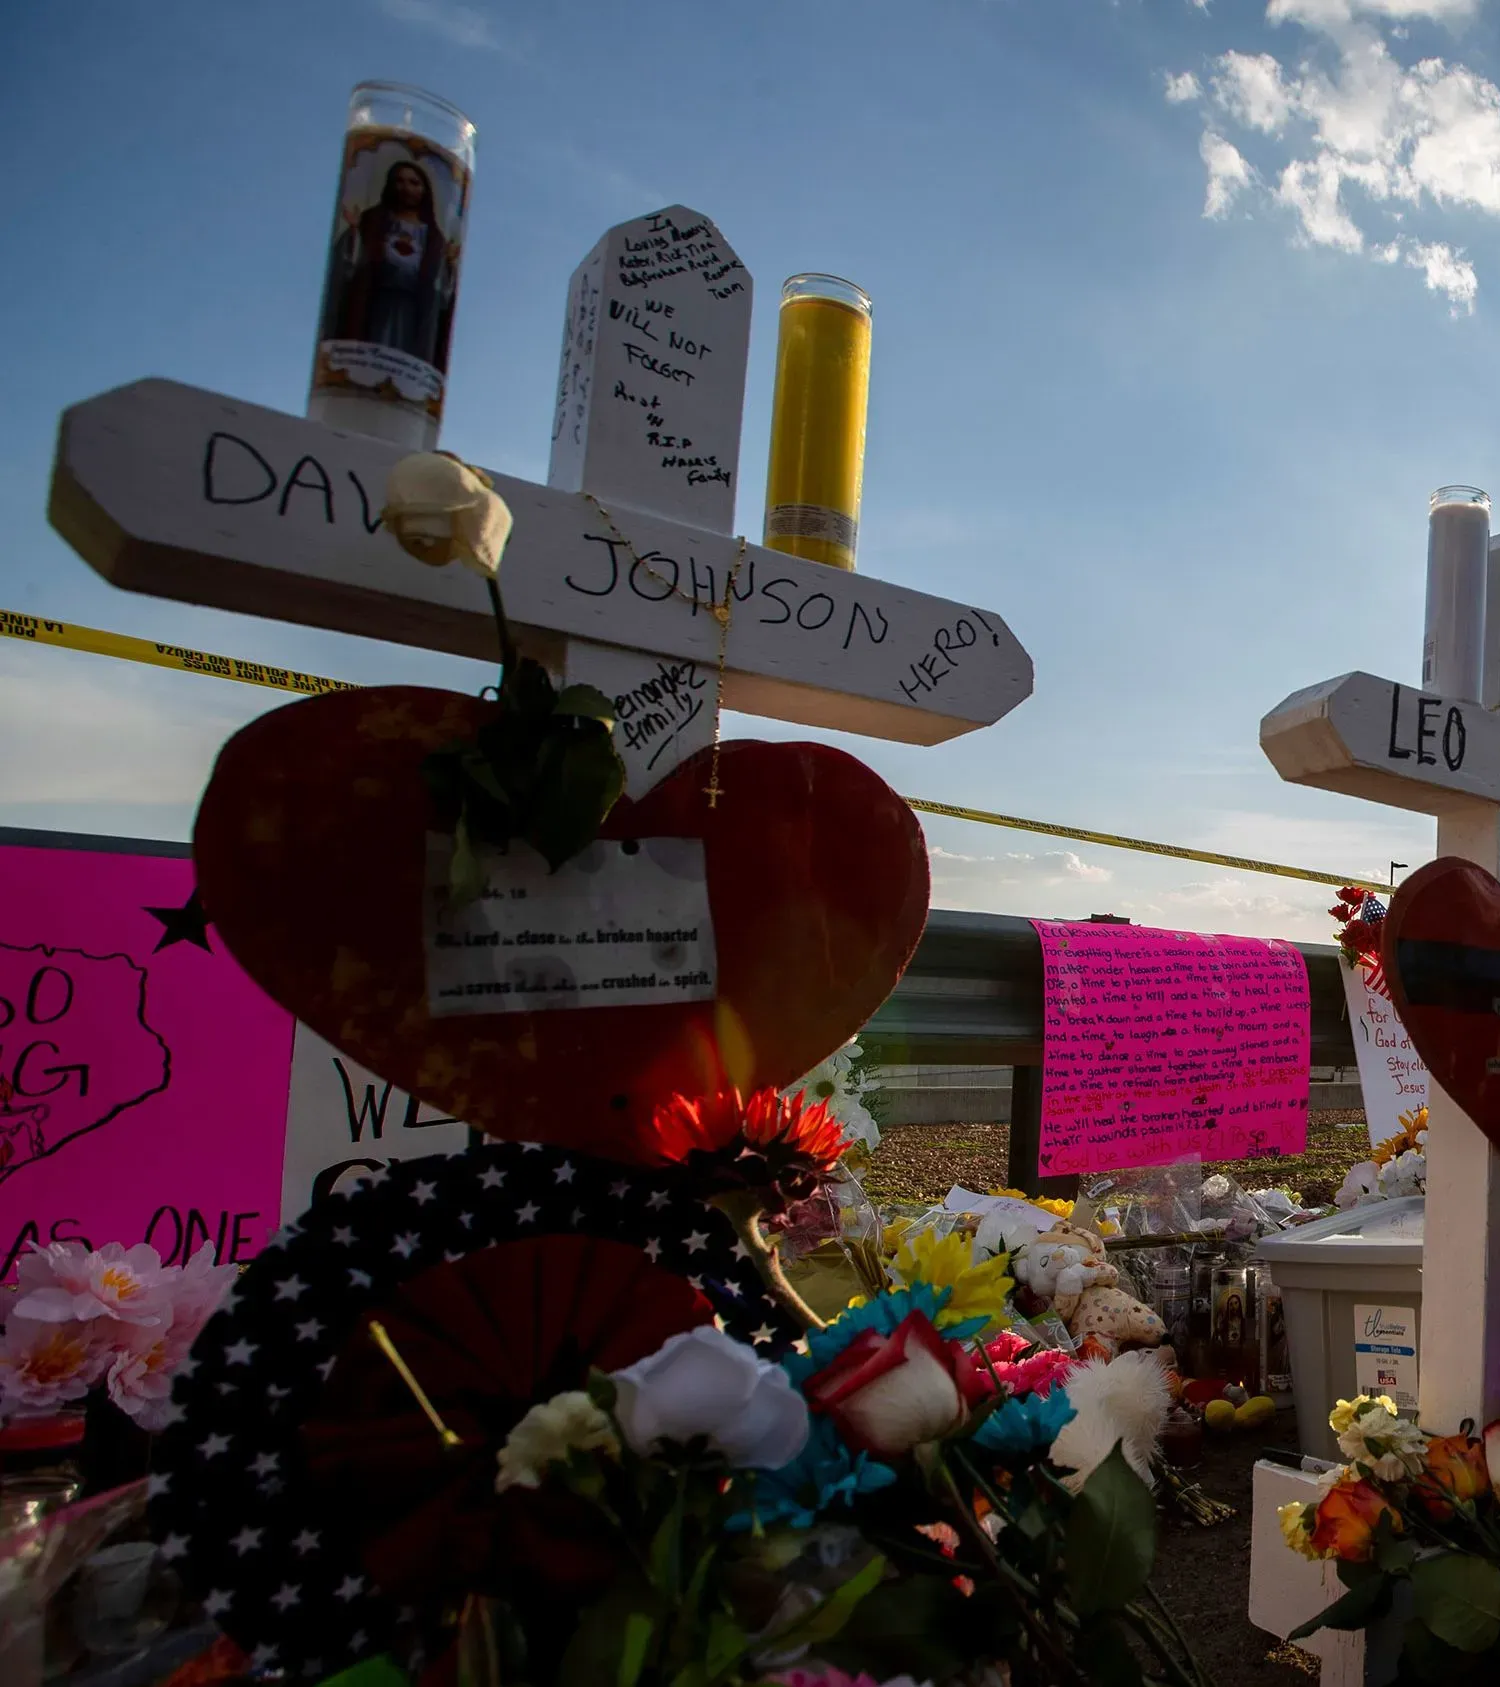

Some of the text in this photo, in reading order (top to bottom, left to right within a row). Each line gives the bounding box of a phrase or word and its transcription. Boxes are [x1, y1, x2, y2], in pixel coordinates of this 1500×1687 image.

[645, 300, 675, 318] WE
[669, 331, 712, 360] NOT
[44, 620, 64, 634] LA
[565, 533, 1003, 703] JOHNSON HERO!
[183, 658, 232, 675] CROSS
[235, 660, 289, 678] POLICIA
[236, 669, 265, 682] NOT
[613, 662, 707, 722] ernandez
[1388, 682, 1466, 772] LEO
[464, 930, 499, 947] Lord
[516, 929, 555, 945] close
[596, 928, 645, 944] broken
[646, 926, 698, 943] hearted
[1091, 965, 1124, 976] under
[466, 981, 511, 997] saves
[601, 972, 656, 990] crushed
[674, 970, 712, 988] spirit.
[1081, 976, 1106, 988] time
[1125, 975, 1151, 989] plant
[1155, 975, 1171, 985] and
[1102, 991, 1127, 1003] time
[1171, 992, 1188, 1000] and
[1134, 1013, 1153, 1023] and
[1165, 1009, 1187, 1020] time
[1206, 1006, 1233, 1019] build
[1366, 998, 1389, 1024] for
[1046, 1032, 1067, 1042] and
[1082, 1028, 1107, 1041] time
[1129, 1029, 1159, 1044] laugh
[1272, 1020, 1290, 1029] and
[1375, 1027, 1397, 1048] God
[1048, 1050, 1076, 1061] time
[1272, 1036, 1289, 1046] and
[1386, 1056, 1411, 1076] Stay
[1045, 1082, 1066, 1094] and
[1392, 1073, 1426, 1096] Jesus
[1044, 1121, 1062, 1134] He
[1065, 1117, 1089, 1131] will
[1120, 1112, 1138, 1123] the
[1229, 1101, 1250, 1115] and
[1044, 1133, 1081, 1148] their
[1087, 1125, 1137, 1144] wounds
[1054, 1147, 1089, 1174] God
[1097, 1147, 1118, 1164] be
[1127, 1137, 1171, 1159] with
[145, 1204, 261, 1269] ONE
[1380, 1377, 1395, 1385] USA
